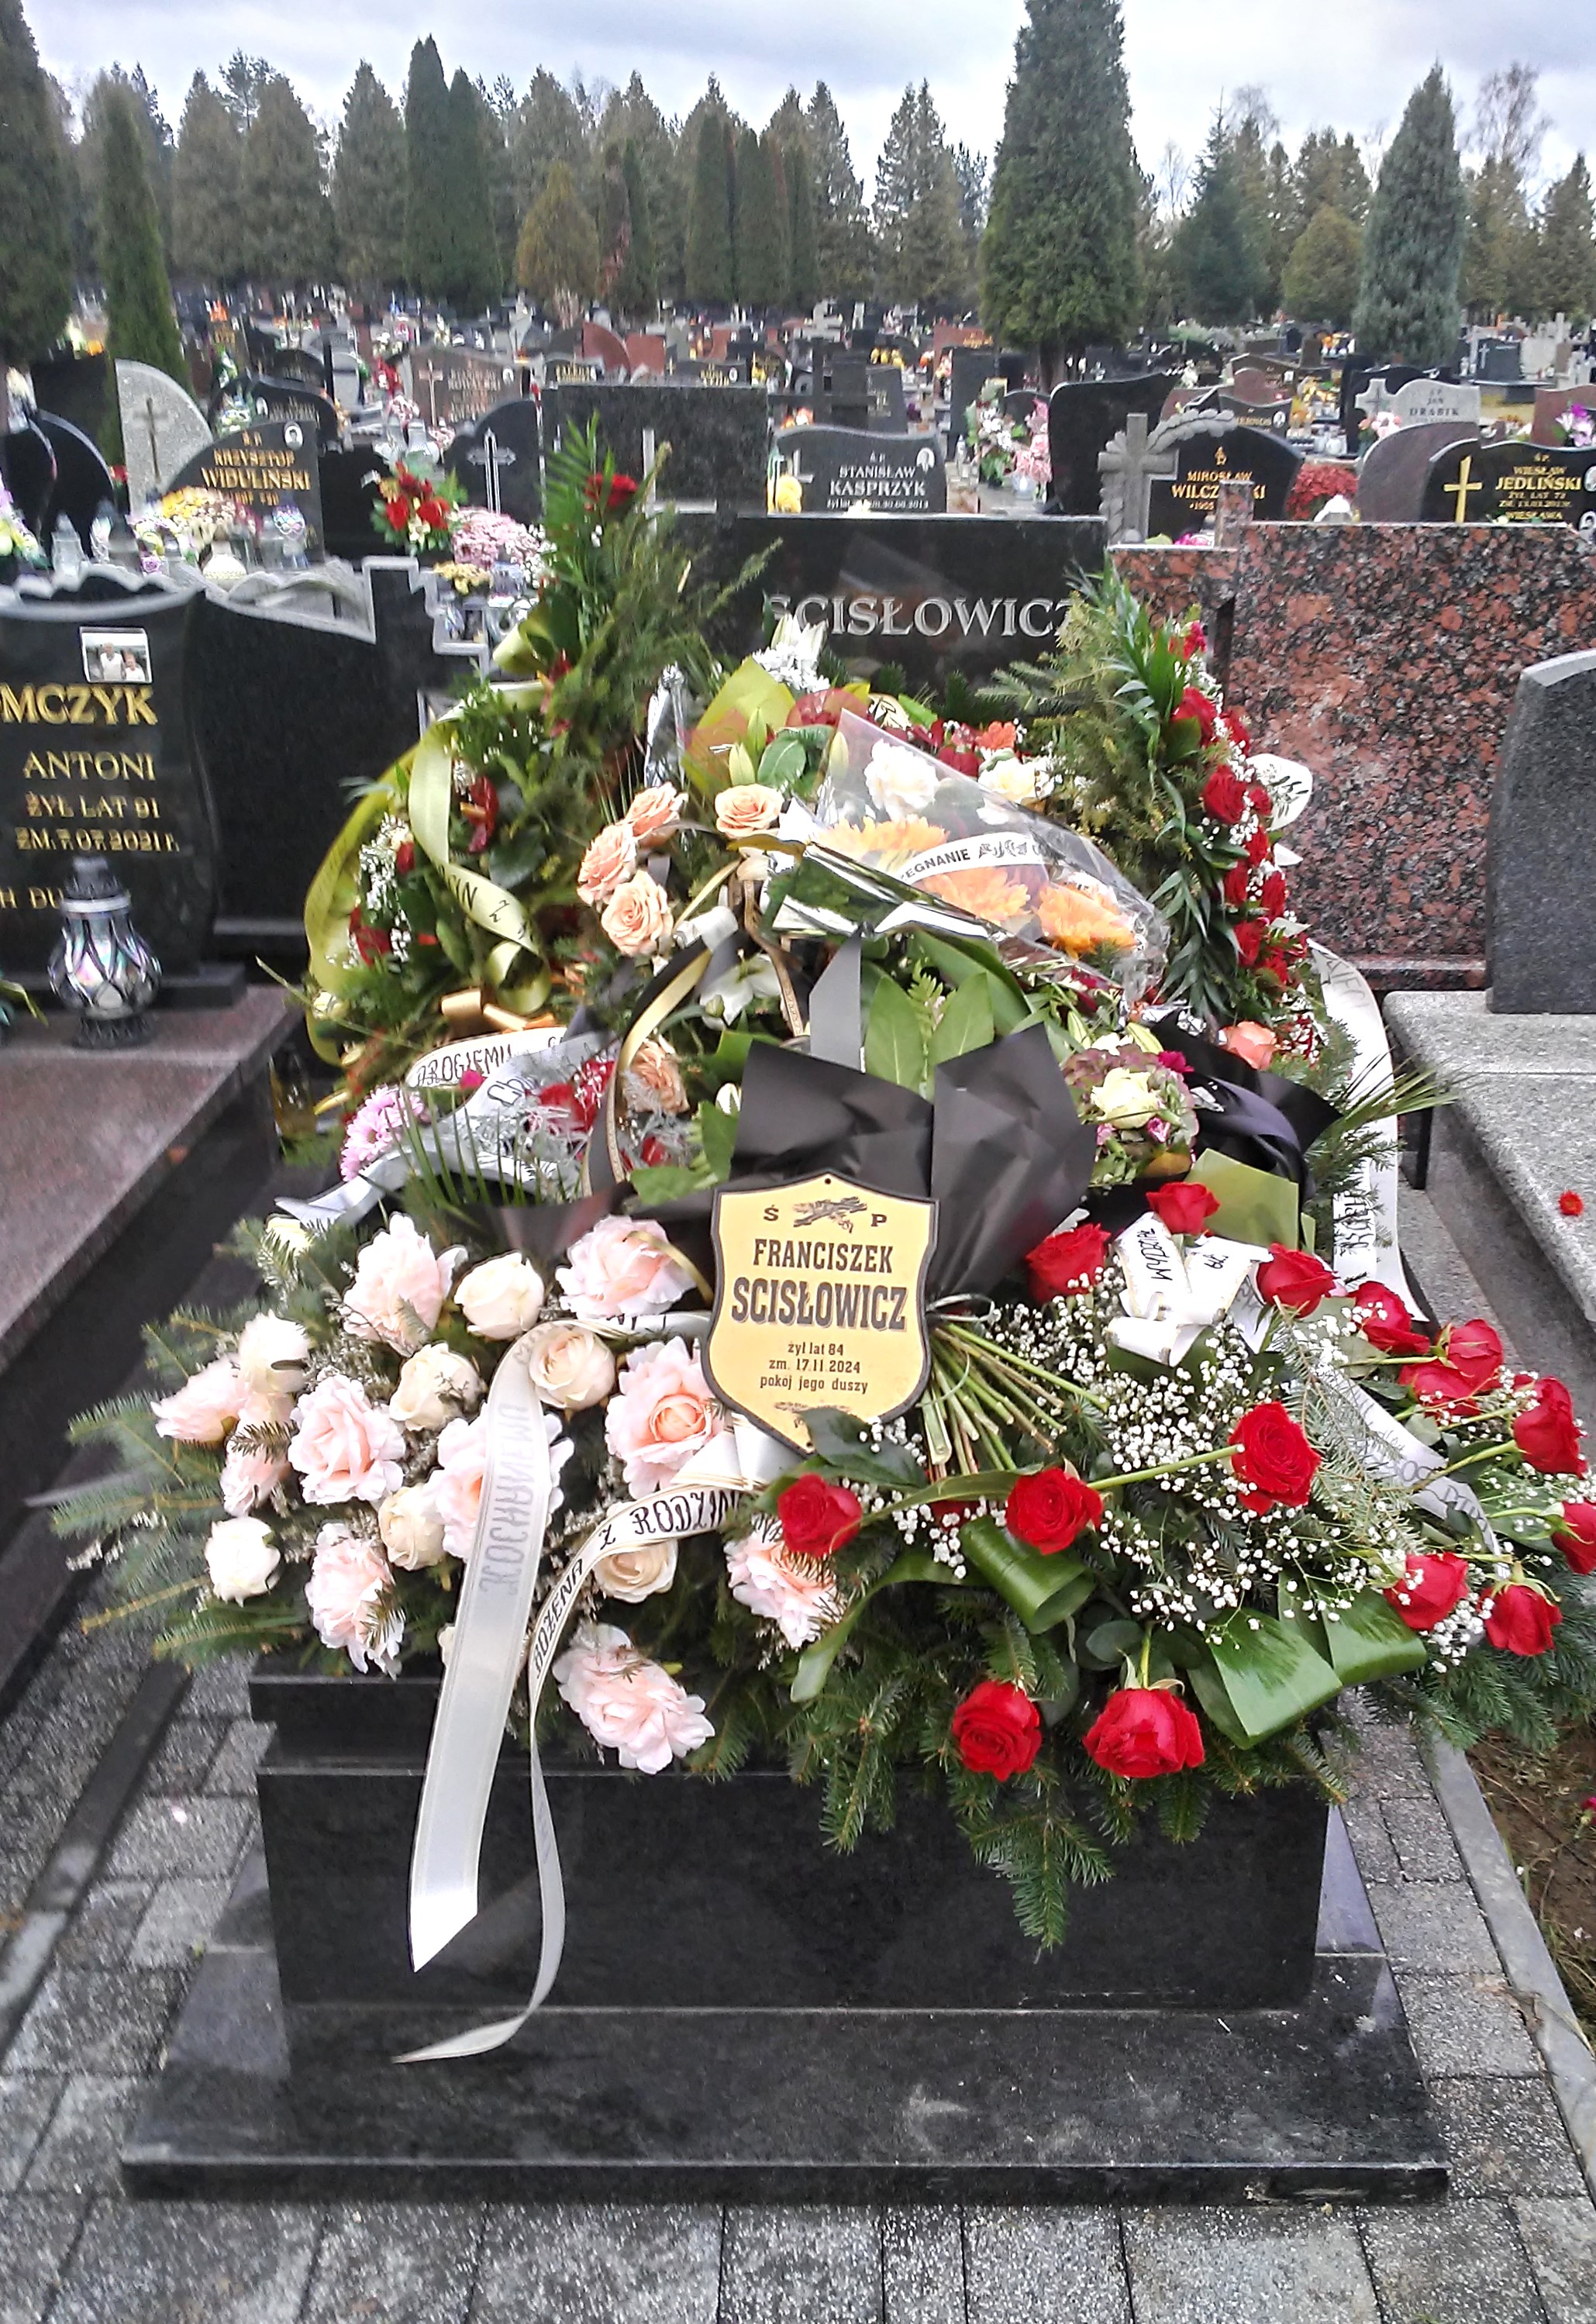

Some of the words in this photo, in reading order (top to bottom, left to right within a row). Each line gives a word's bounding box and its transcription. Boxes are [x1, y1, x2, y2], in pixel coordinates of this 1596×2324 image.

[829, 479, 926, 497] KASPRZYK
[1494, 474, 1583, 491] JEDLIŃSKI
[22, 750, 156, 781] ANTONI
[78, 794, 129, 819] LAT
[870, 1213, 888, 1228] P
[753, 1238, 894, 1274] FRANCISZEK
[731, 1277, 908, 1332] SCISŁOWICZ
[808, 1342, 825, 1356] lat
[827, 1343, 845, 1357] 84
[798, 1375, 826, 1393] jego
[831, 1377, 869, 1395] duszy
[629, 1488, 741, 1536] RODZIN
